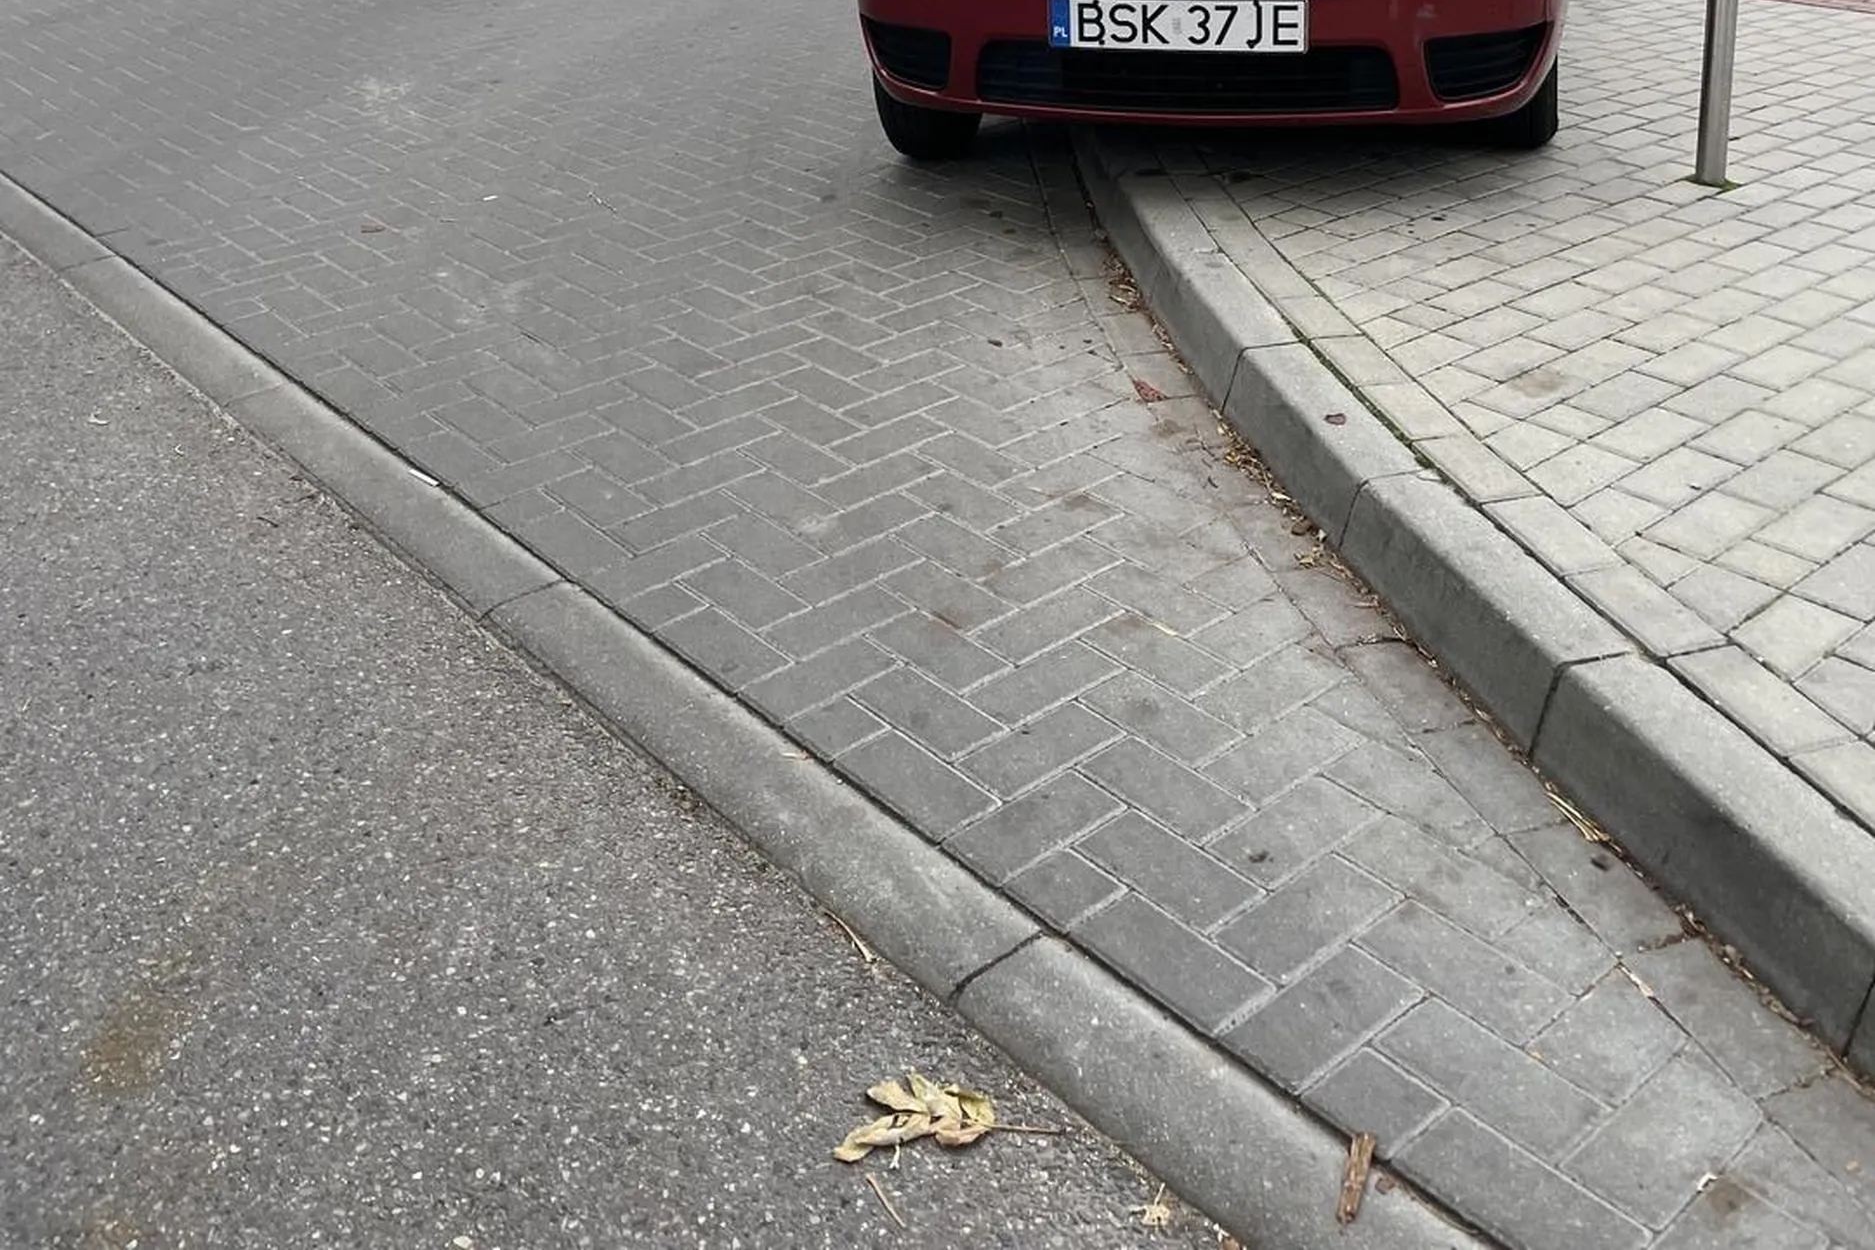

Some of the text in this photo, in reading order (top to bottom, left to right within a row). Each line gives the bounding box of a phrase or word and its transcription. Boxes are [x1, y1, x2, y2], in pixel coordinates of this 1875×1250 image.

[1053, 26, 1067, 38] PL
[1077, 0, 1300, 48] BSK 37JE
